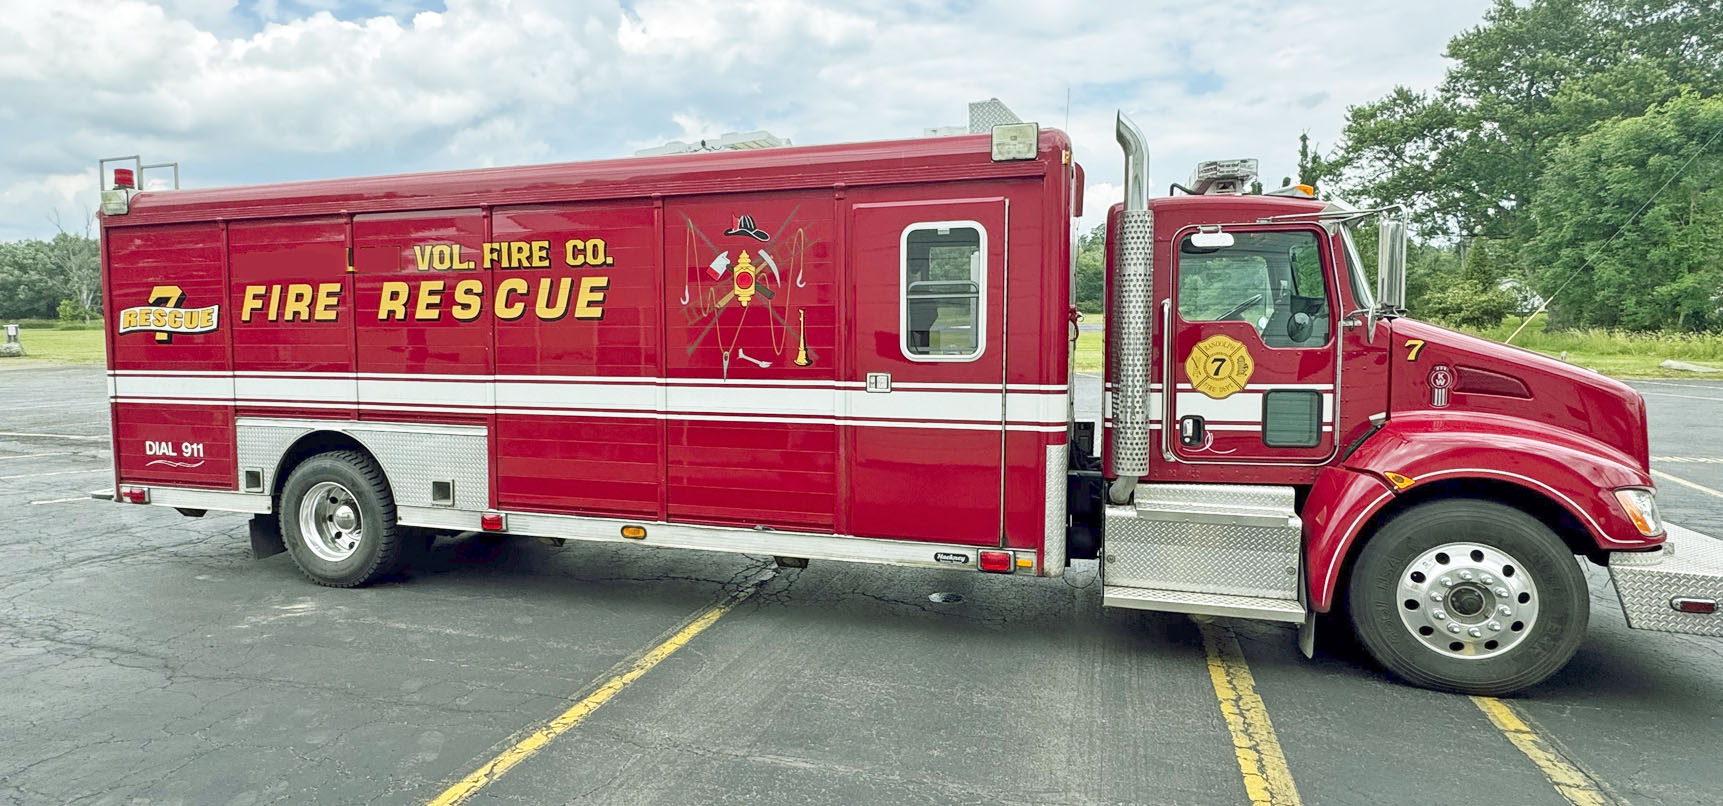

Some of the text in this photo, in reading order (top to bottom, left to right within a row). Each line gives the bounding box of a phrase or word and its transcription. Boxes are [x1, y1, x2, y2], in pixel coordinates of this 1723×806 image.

[414, 238, 614, 271] VOL. FIRE CO.
[241, 276, 610, 323] FIRE RESCUE
[123, 308, 214, 330] RESCUE
[148, 285, 185, 343] 7
[1404, 339, 1426, 362] 7
[1211, 357, 1227, 377] 7
[145, 440, 204, 458] DIAL 911
[936, 553, 967, 563] Hackney
